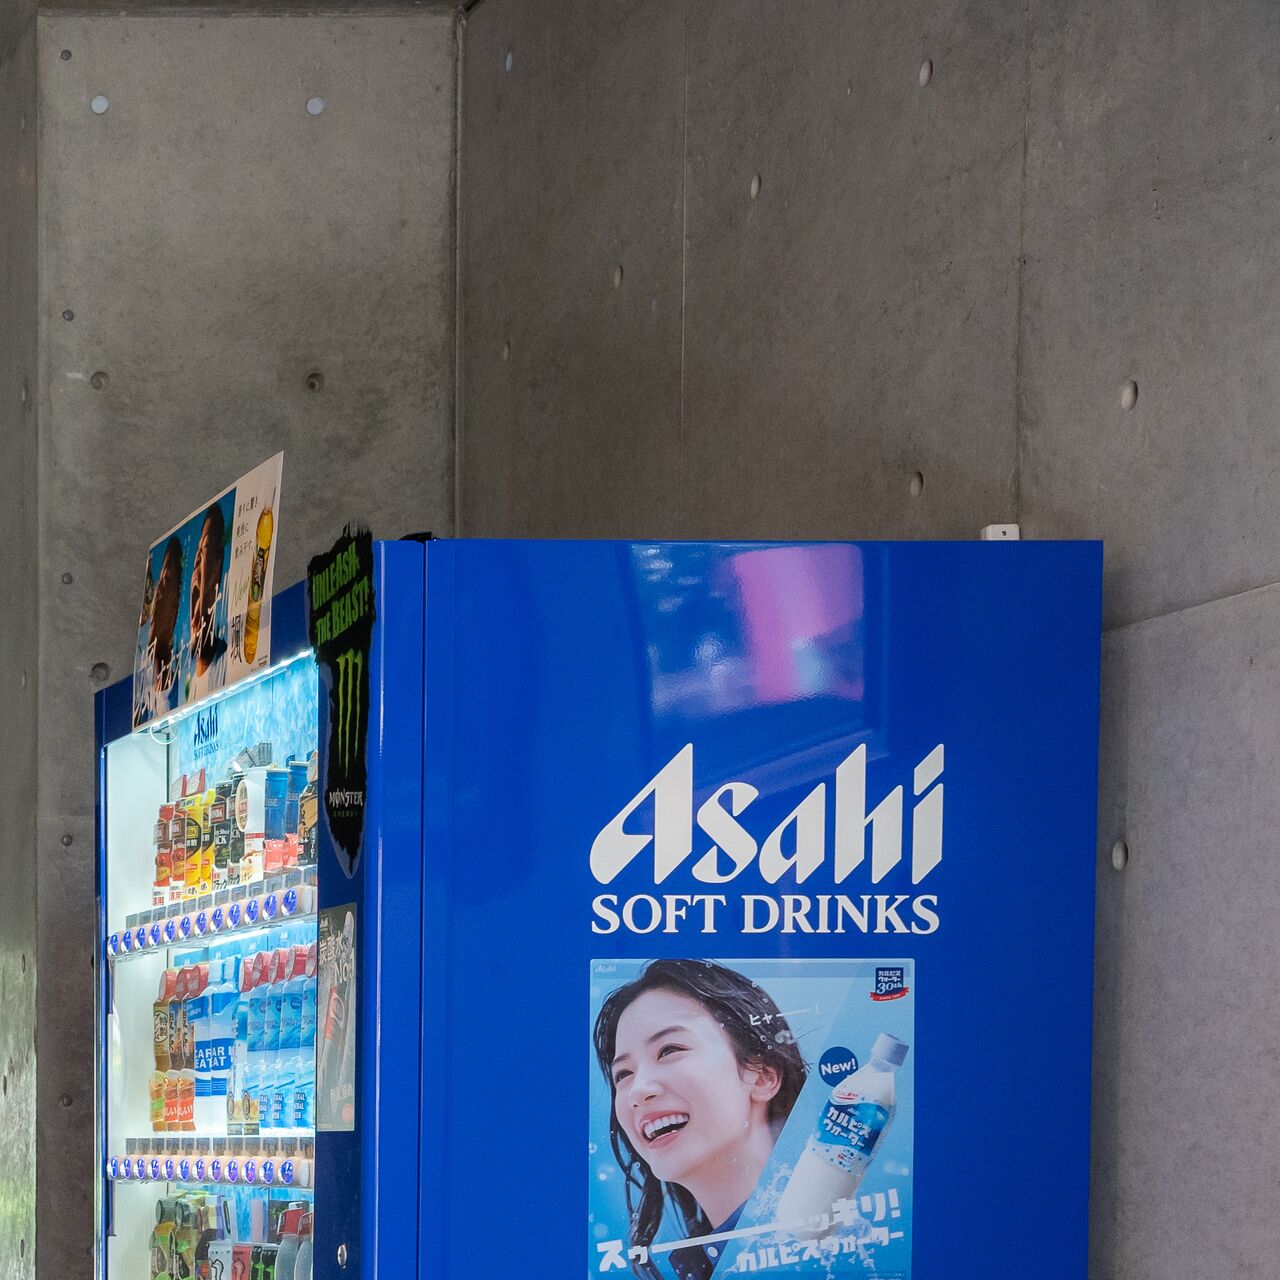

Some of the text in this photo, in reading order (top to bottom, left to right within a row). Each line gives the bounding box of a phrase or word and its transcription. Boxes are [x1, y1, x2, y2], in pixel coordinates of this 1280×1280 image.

[312, 541, 358, 611] UNLEASH
[316, 576, 369, 646] THE BEAST!
[194, 703, 219, 747] Asahi
[329, 788, 364, 808] MONSTER
[590, 743, 945, 885] Asahi
[591, 894, 940, 935] SOFT DRINKS
[876, 982, 903, 994] 30th
[821, 1058, 857, 1075] New!
[826, 1106, 872, 1139] カルピス
[735, 1226, 904, 1272] カルピスウォーター
